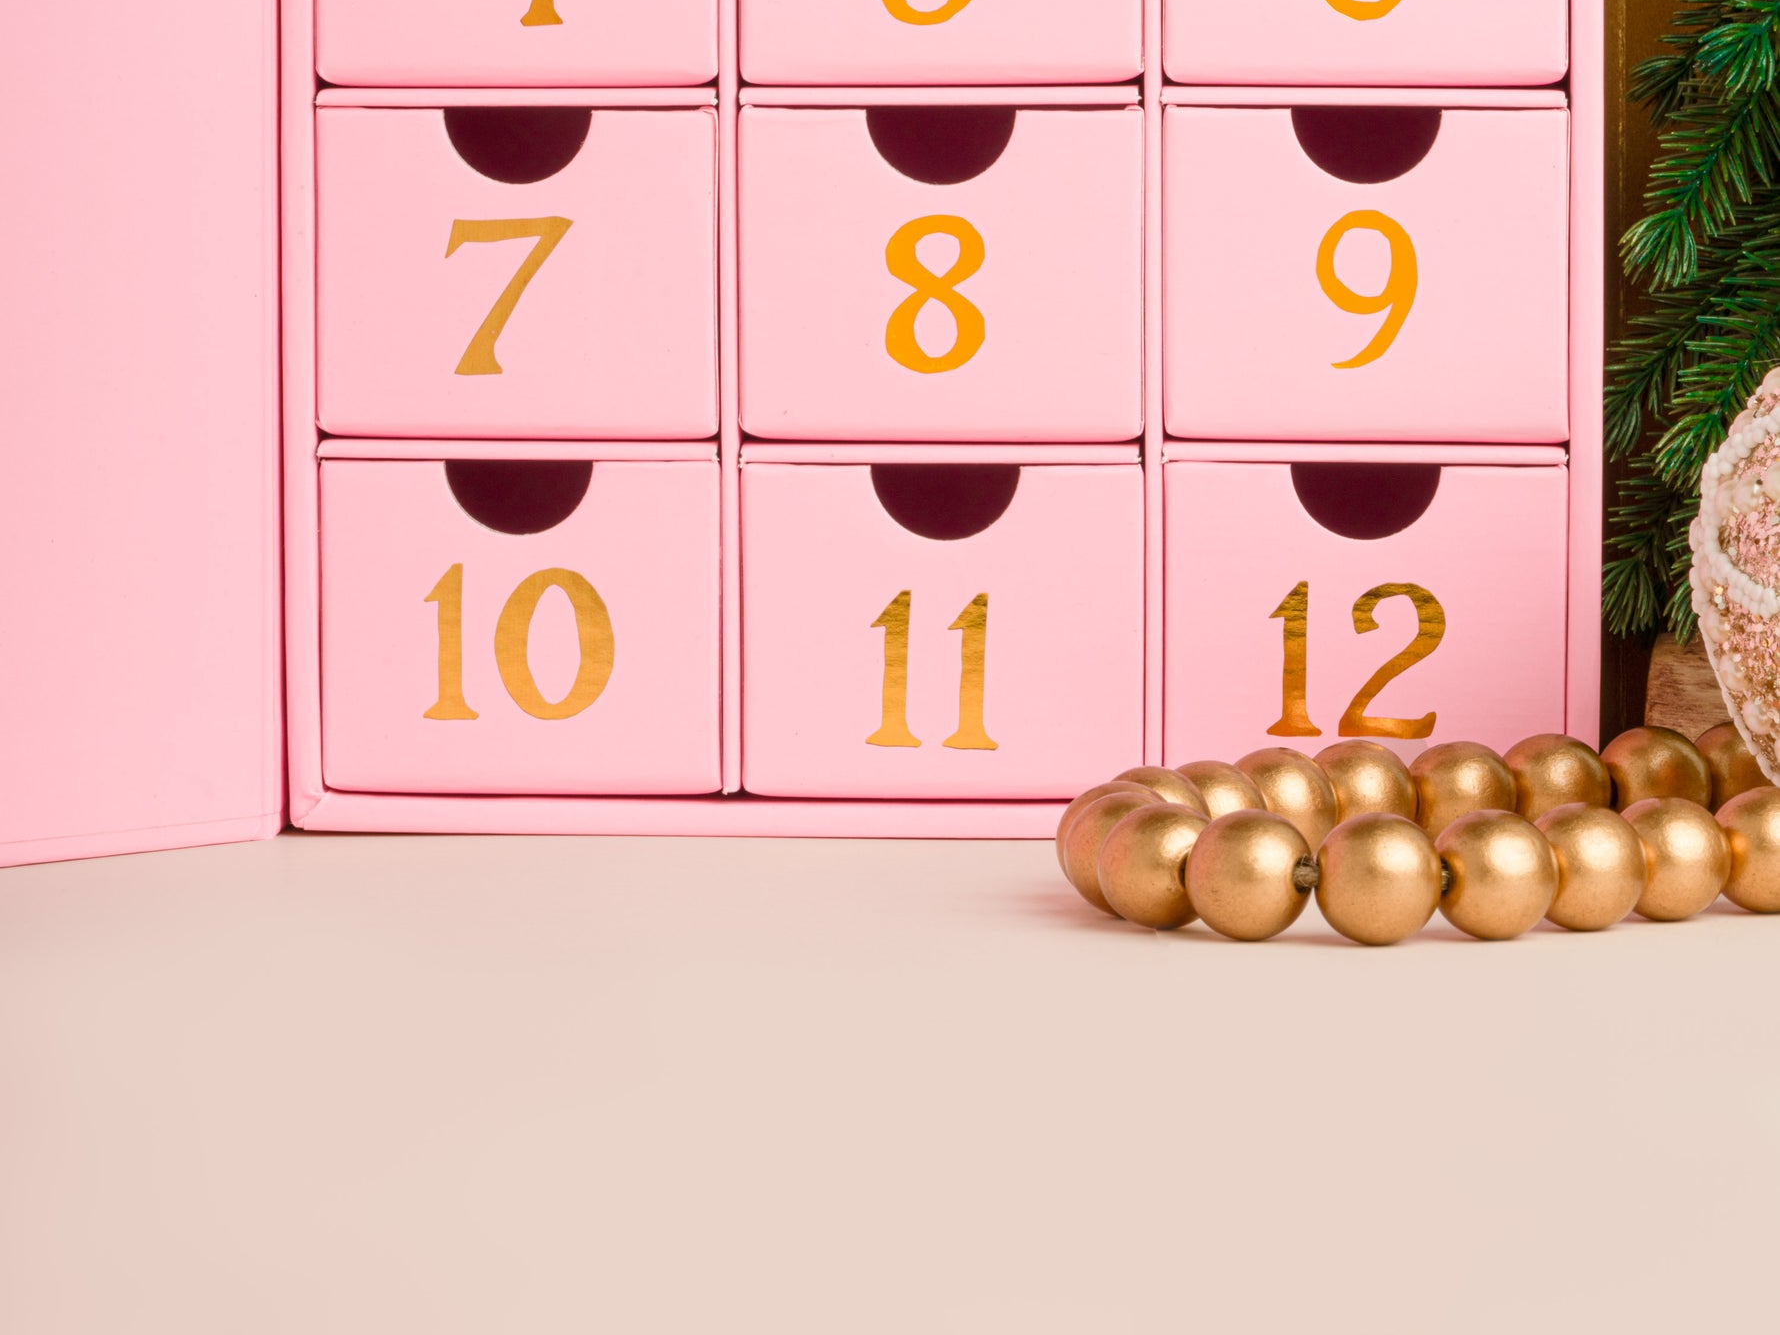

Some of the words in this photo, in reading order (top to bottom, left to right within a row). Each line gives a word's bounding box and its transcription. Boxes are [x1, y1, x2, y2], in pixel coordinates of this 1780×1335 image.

[446, 216, 573, 375] 7
[885, 214, 985, 374] 8
[1316, 210, 1418, 369] 9
[423, 563, 615, 720] 10
[866, 589, 999, 750] 11
[1267, 581, 1446, 739] 12
